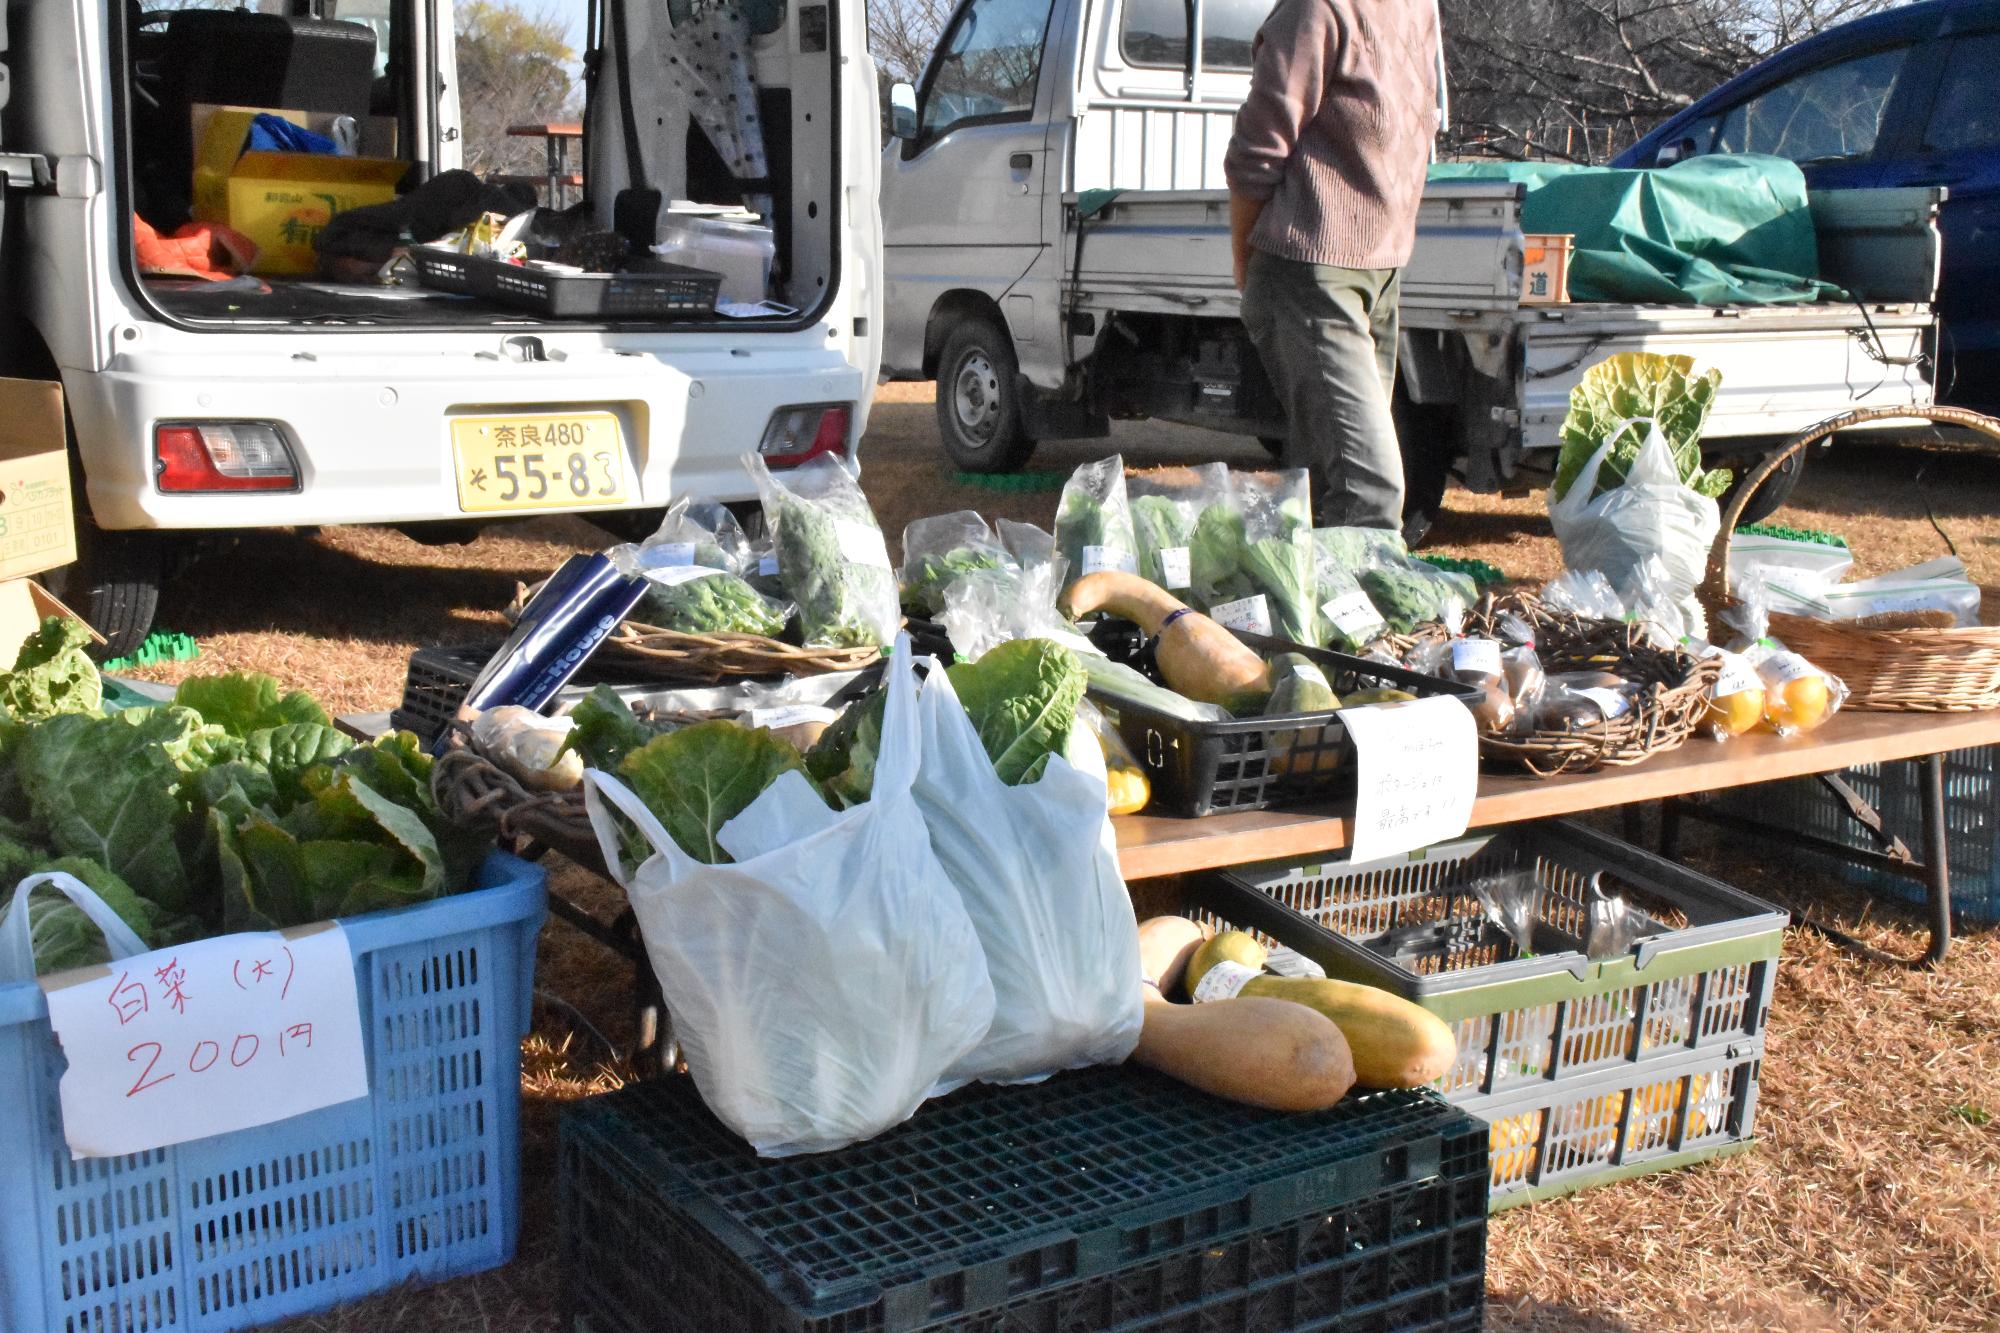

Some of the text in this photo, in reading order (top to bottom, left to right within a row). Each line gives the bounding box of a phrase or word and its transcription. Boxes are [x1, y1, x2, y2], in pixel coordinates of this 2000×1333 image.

[1529, 271, 1548, 296] 道
[470, 452, 617, 501] そ 55-83
[108, 956, 192, 1025] 白菜
[126, 1022, 312, 1098] 200円
